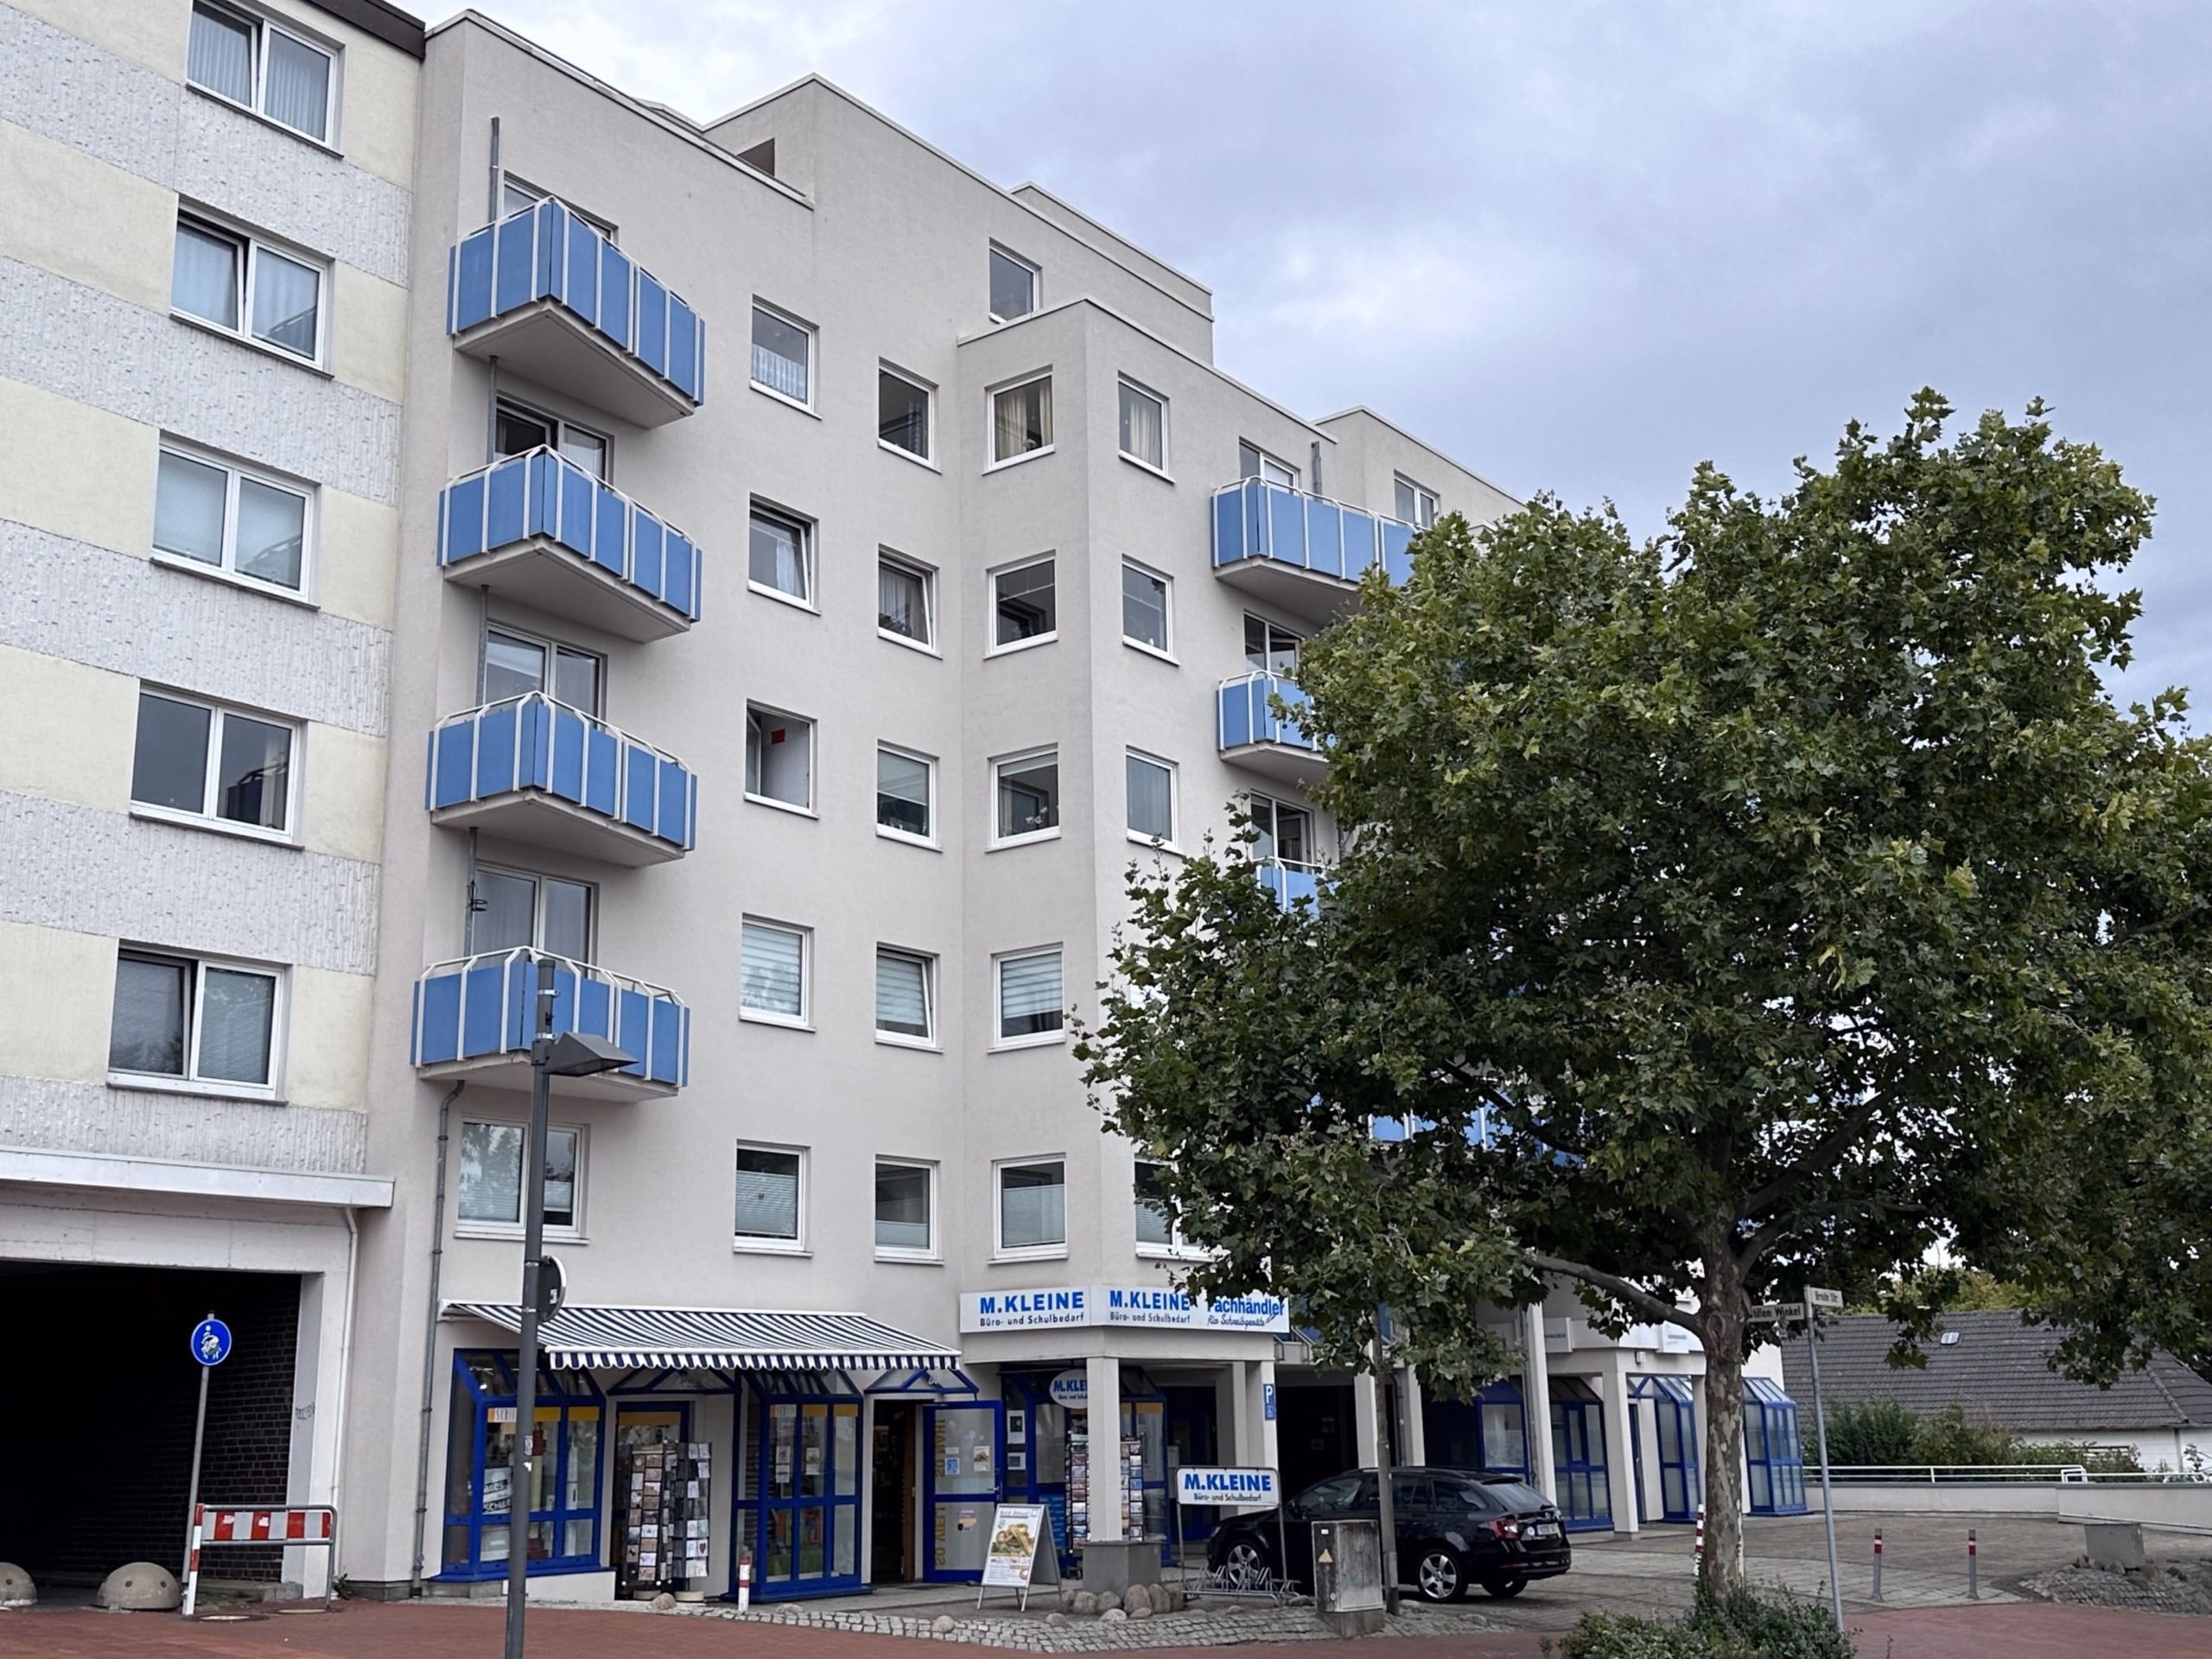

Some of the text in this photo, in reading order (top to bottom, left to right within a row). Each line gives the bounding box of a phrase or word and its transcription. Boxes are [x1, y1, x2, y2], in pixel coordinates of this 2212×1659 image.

[980, 1291, 1084, 1314] M.KLEINE
[1109, 1290, 1191, 1312] M.KLEINE
[1207, 1296, 1285, 1316] achhändler
[980, 1312, 1085, 1327] Büro- und Schulbedarf
[1109, 1312, 1191, 1324] Büro- und Schulbedarf
[1751, 1305, 1802, 1319] tillen Winkel
[1265, 1385, 1274, 1404] P
[1185, 1473, 1272, 1491] M.KLEINE
[1211, 1492, 1224, 1501] und
[1224, 1492, 1262, 1503] Schulbedarf
